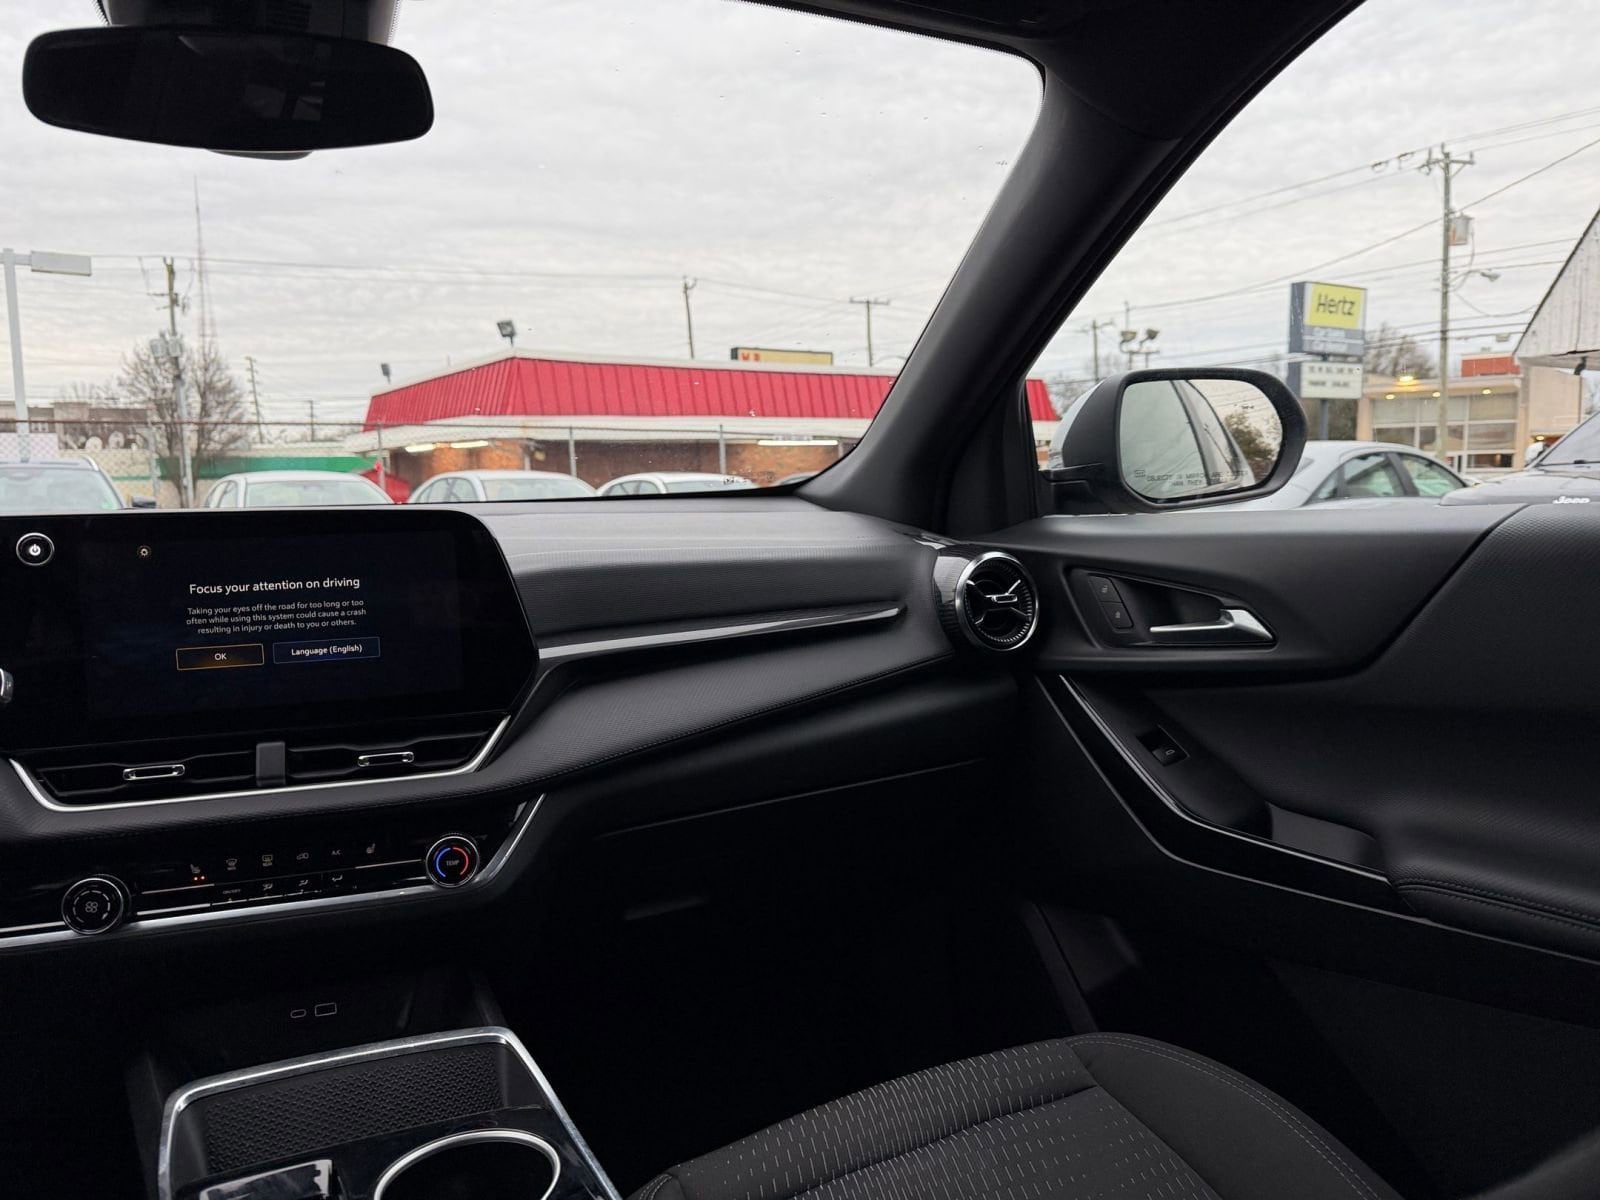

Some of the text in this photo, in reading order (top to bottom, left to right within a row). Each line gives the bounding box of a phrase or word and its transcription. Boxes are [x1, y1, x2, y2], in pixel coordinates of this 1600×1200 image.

[1316, 293, 1356, 316] Hertz
[189, 577, 360, 596] Focus your attention on driving
[187, 607, 213, 616] Taking
[214, 607, 232, 615] your
[232, 606, 250, 614] eyes
[251, 603, 263, 611] off
[264, 603, 277, 611] the
[278, 602, 296, 610] road
[297, 601, 308, 609] for
[323, 600, 340, 609] long
[186, 616, 207, 625] often
[208, 615, 229, 624] while
[230, 615, 251, 623] using
[252, 613, 267, 621] this
[268, 613, 295, 622] system
[296, 610, 317, 619] could
[317, 610, 339, 618] cause
[346, 608, 367, 616] crash
[197, 625, 232, 634] resulting
[241, 624, 263, 633] injury
[273, 621, 296, 630] death
[296, 621, 305, 629] to
[306, 622, 320, 630] you
[330, 619, 357, 627] others.
[214, 652, 228, 661] OK
[291, 644, 363, 657] Language (English)
